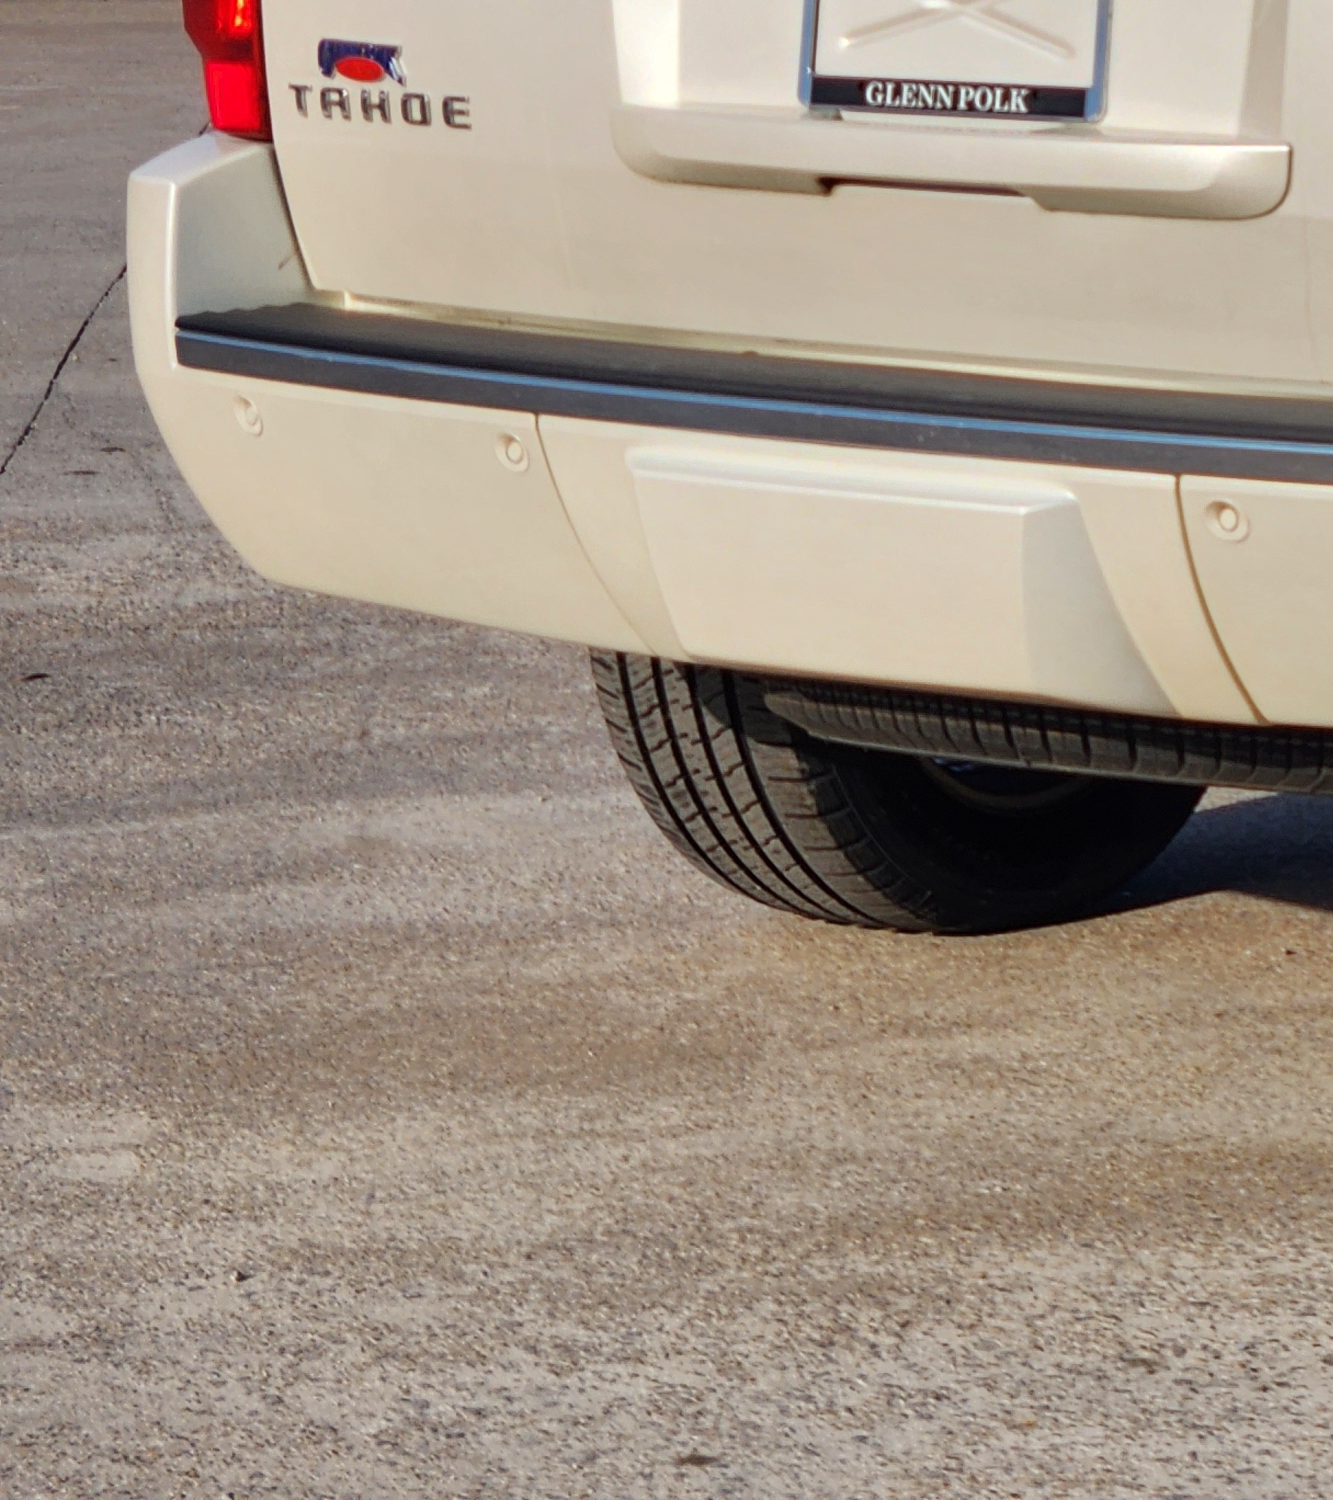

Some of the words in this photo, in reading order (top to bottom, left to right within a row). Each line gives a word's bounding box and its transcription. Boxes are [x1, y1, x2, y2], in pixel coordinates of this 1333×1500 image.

[288, 83, 472, 130] TAHOE
[865, 81, 955, 110] GLENN
[957, 86, 1030, 114] POLK
